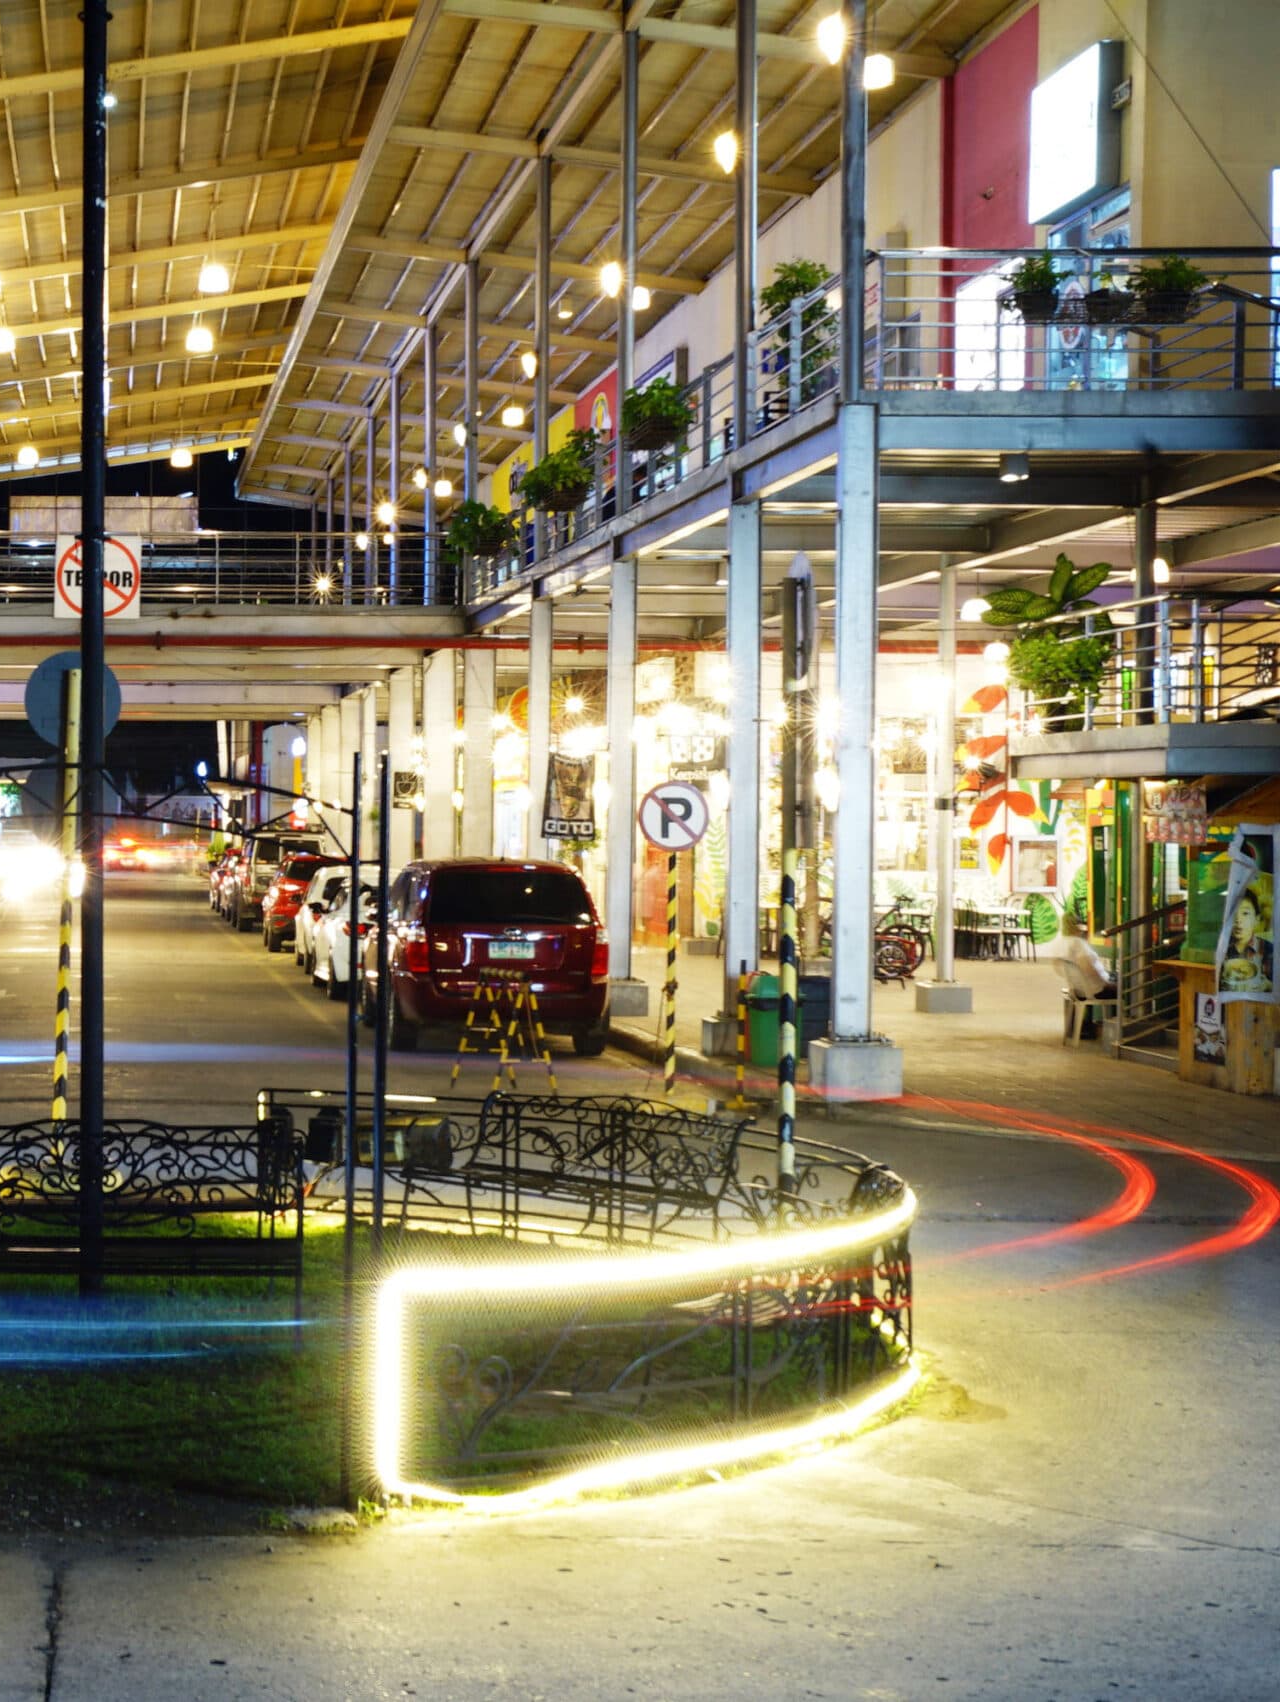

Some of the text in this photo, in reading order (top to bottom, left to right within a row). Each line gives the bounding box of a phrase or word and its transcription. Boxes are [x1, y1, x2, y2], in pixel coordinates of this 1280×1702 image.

[64, 570, 133, 588] TEOR
[544, 819, 593, 835] GOTO
[661, 797, 692, 839] P
